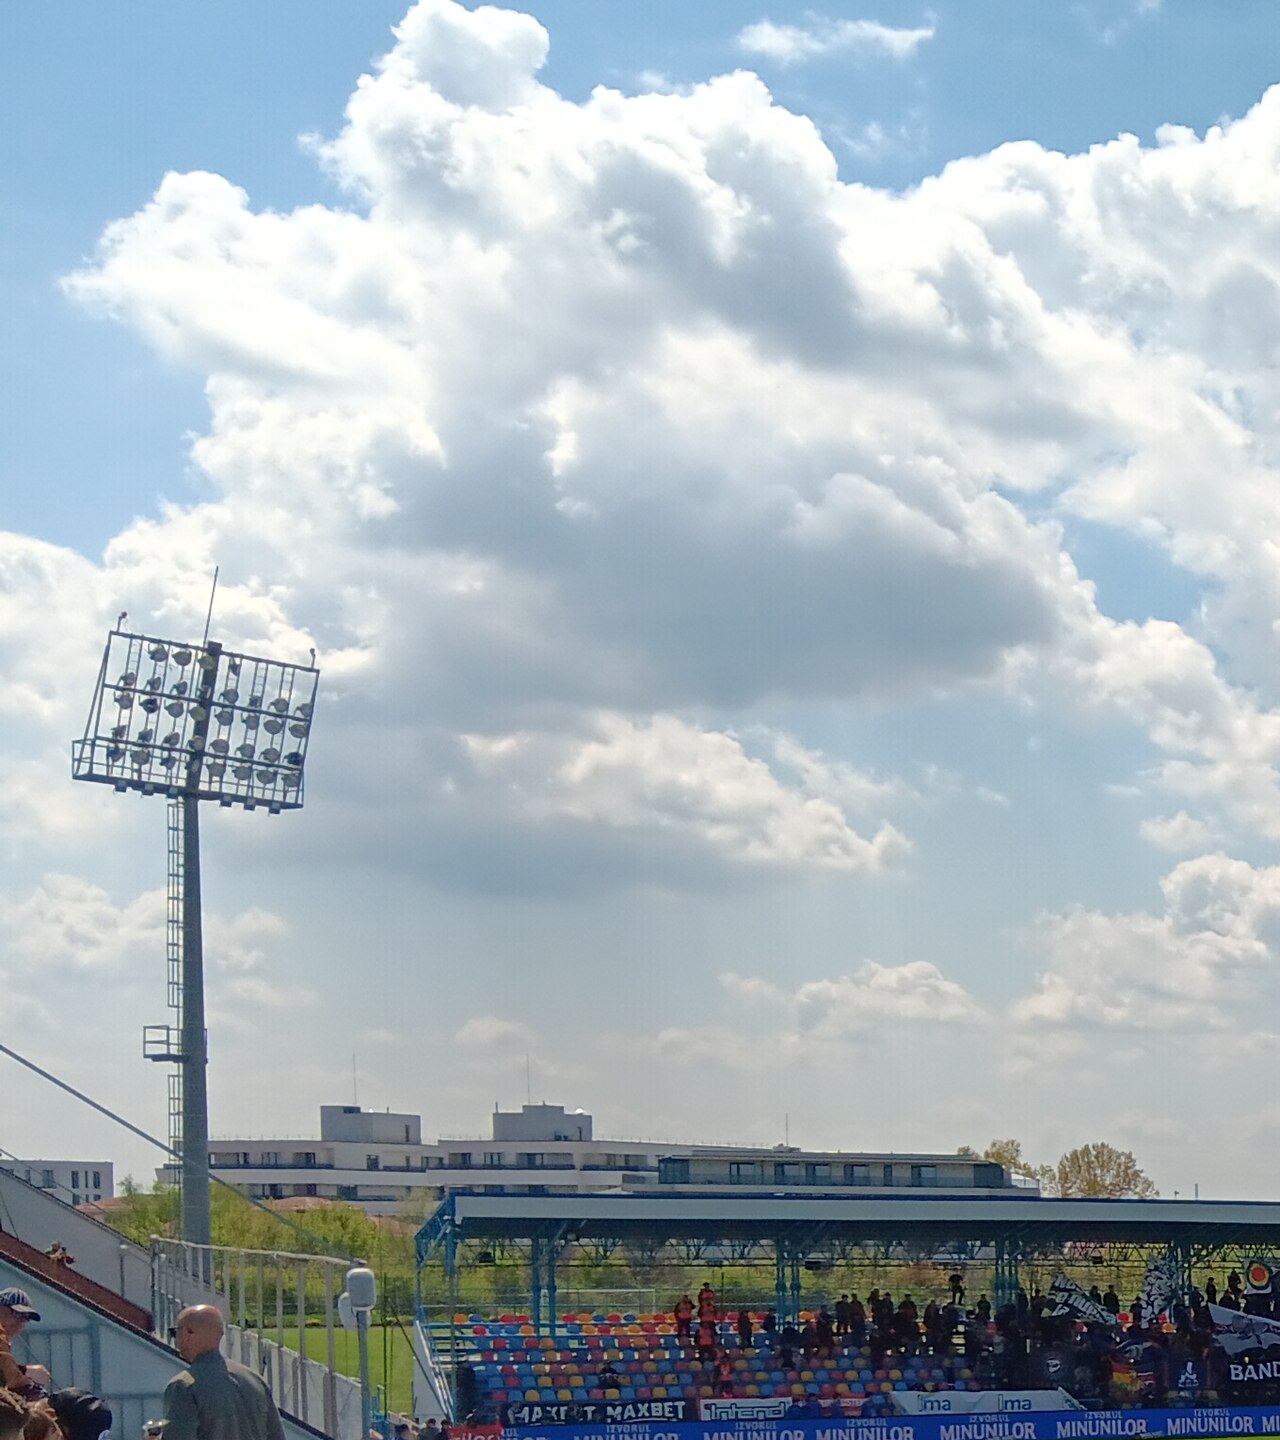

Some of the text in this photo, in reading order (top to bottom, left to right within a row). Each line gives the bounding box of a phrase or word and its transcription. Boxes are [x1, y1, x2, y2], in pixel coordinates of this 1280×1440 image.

[606, 1401, 686, 1423] MAXBET
[1056, 1417, 1149, 1439] MINUNILOR
[1167, 1415, 1254, 1436] MINUNILOR
